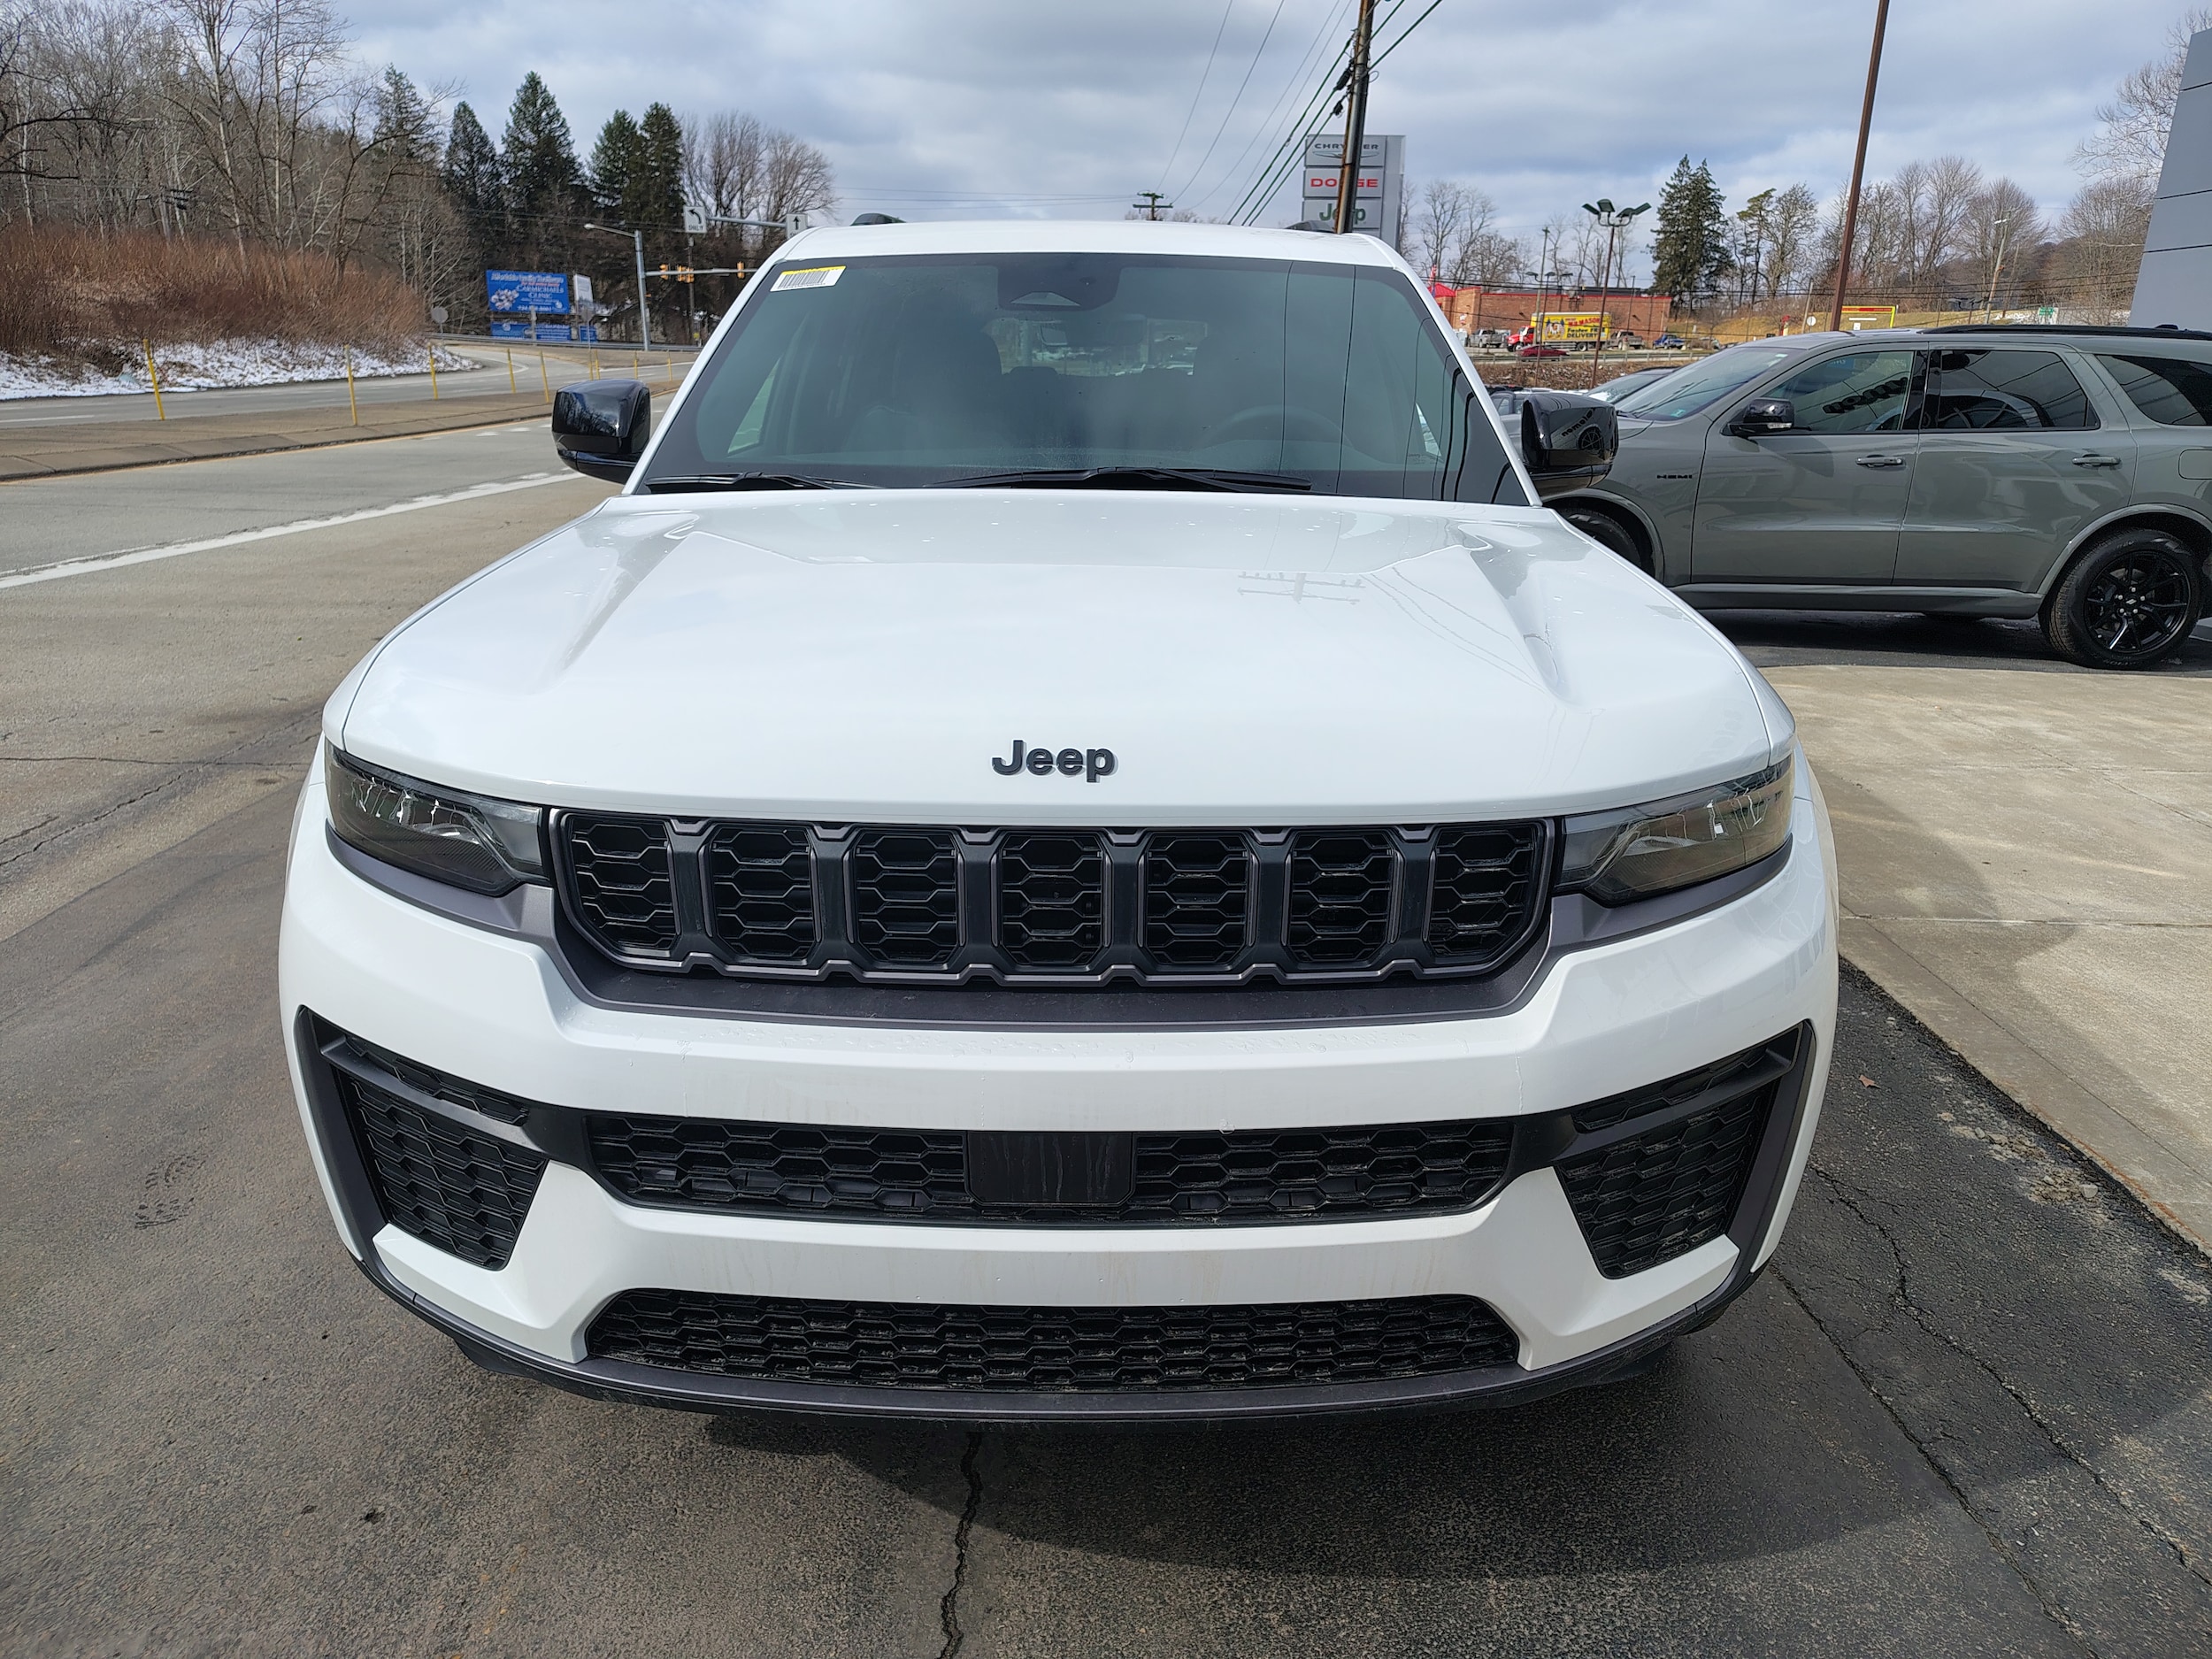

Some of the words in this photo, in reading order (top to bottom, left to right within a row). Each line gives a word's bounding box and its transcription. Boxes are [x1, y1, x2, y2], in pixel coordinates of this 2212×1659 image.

[1310, 179, 1379, 188] DOGE
[1319, 204, 1366, 224] Jp
[991, 740, 1117, 783] Jeep
